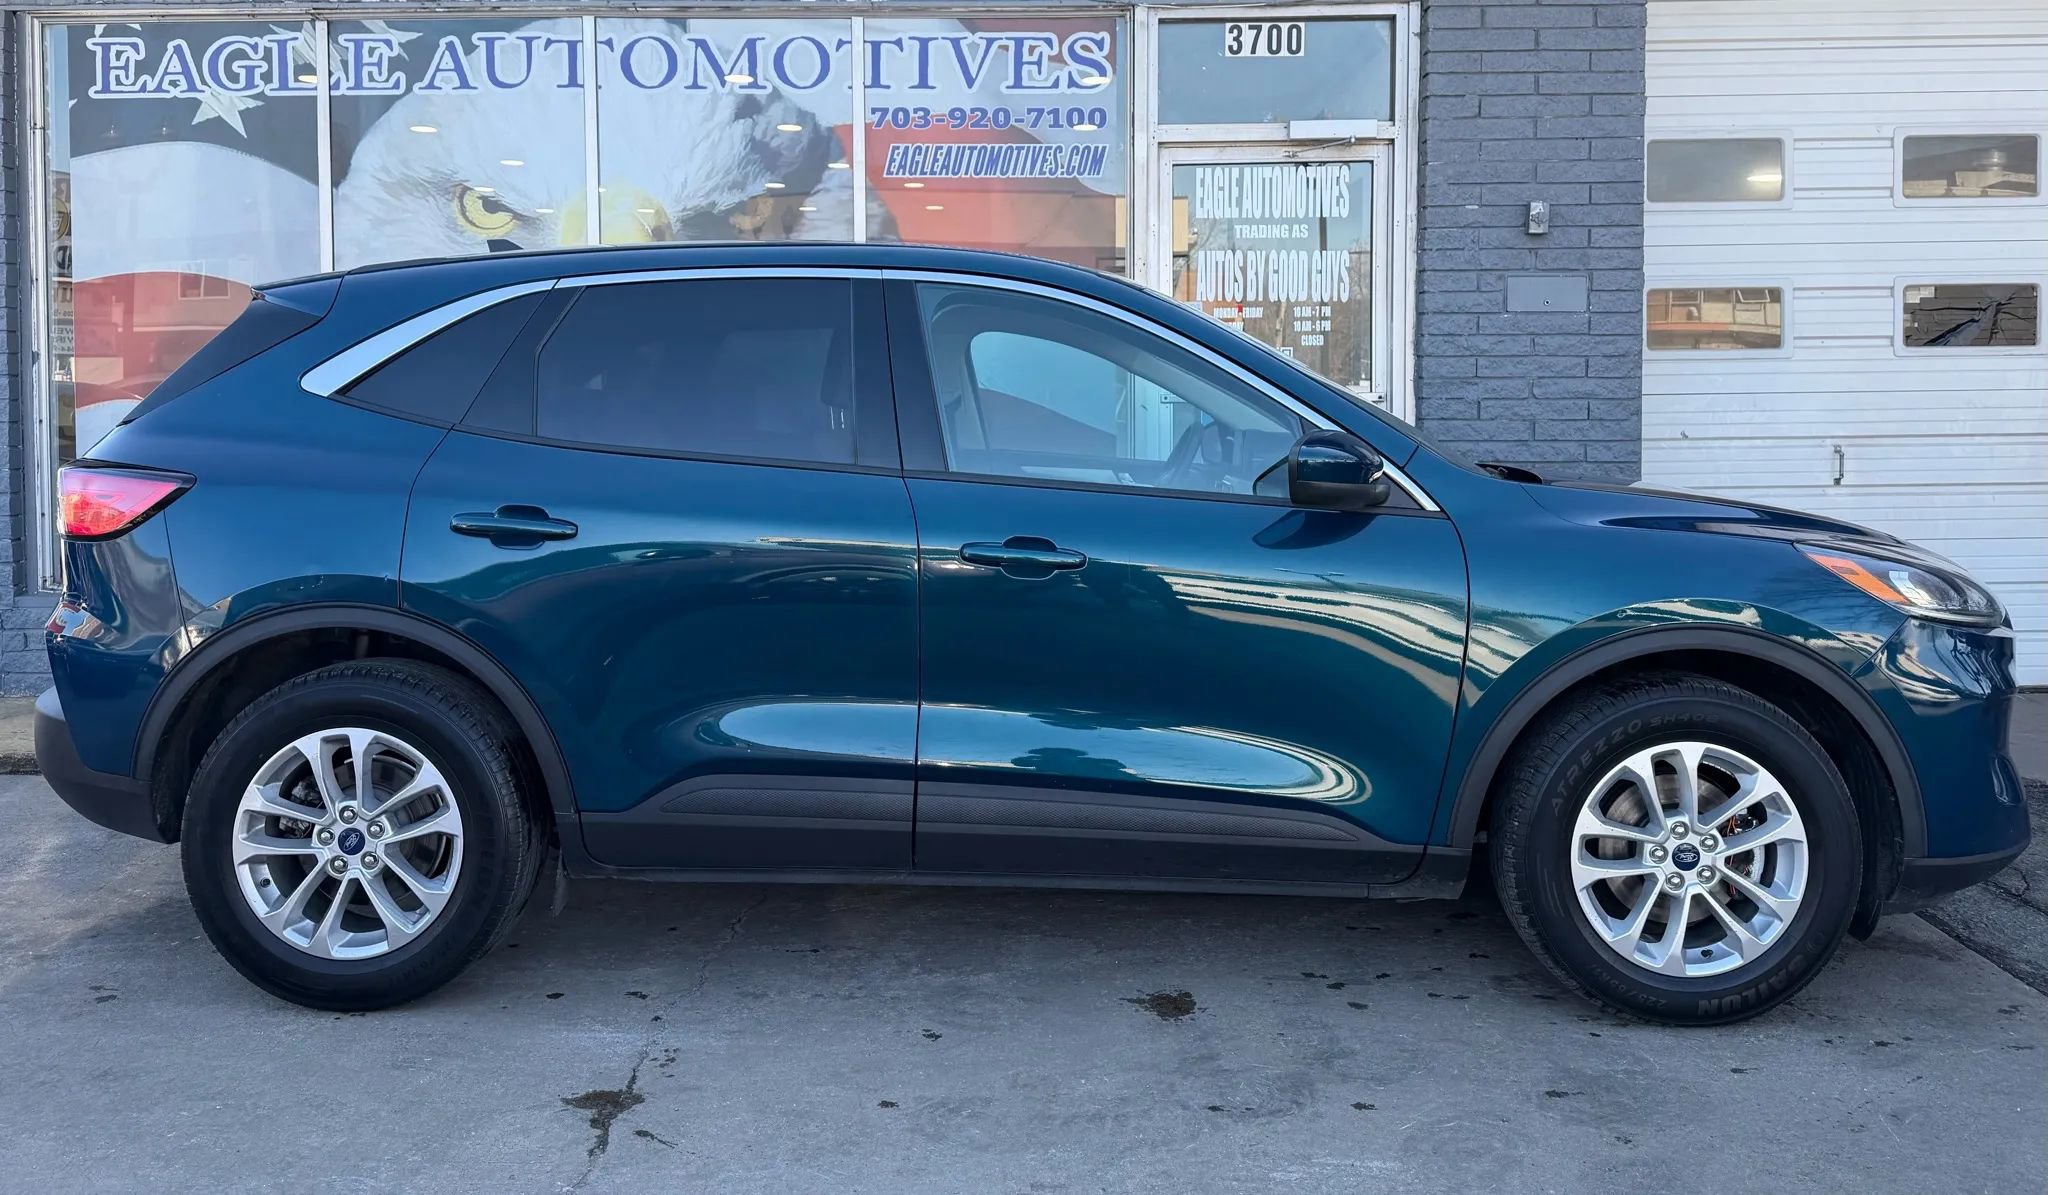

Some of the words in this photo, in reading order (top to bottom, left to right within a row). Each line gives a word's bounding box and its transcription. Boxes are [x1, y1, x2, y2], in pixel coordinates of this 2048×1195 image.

[1227, 24, 1302, 55] 3700
[87, 34, 405, 97] EAGLE
[415, 30, 1111, 94] AUTOMOTIVES
[871, 107, 1107, 129] 703-920-7100
[885, 144, 1108, 177] EAGLEAUTOMOTIVES.COM
[1196, 166, 1239, 219] EAGLE
[1242, 165, 1350, 219] AUTOMOTIVES
[1235, 224, 1289, 239] TRADING
[1292, 224, 1309, 238] AS
[1197, 250, 1244, 303] AUTOS
[1247, 250, 1266, 301] BY
[1269, 249, 1308, 303] GOOD
[1312, 249, 1350, 303] GUYS
[1243, 306, 1264, 318] FRIDAY
[1293, 306, 1301, 318] 10
[1302, 306, 1312, 317] AM
[1316, 305, 1320, 317] 7
[1321, 305, 1331, 317] PM
[1293, 320, 1301, 332] 10
[1302, 320, 1312, 332] AM
[1321, 320, 1331, 331] PM
[1301, 334, 1324, 346] CLOSED
[1551, 718, 1642, 816] ATREZZO
